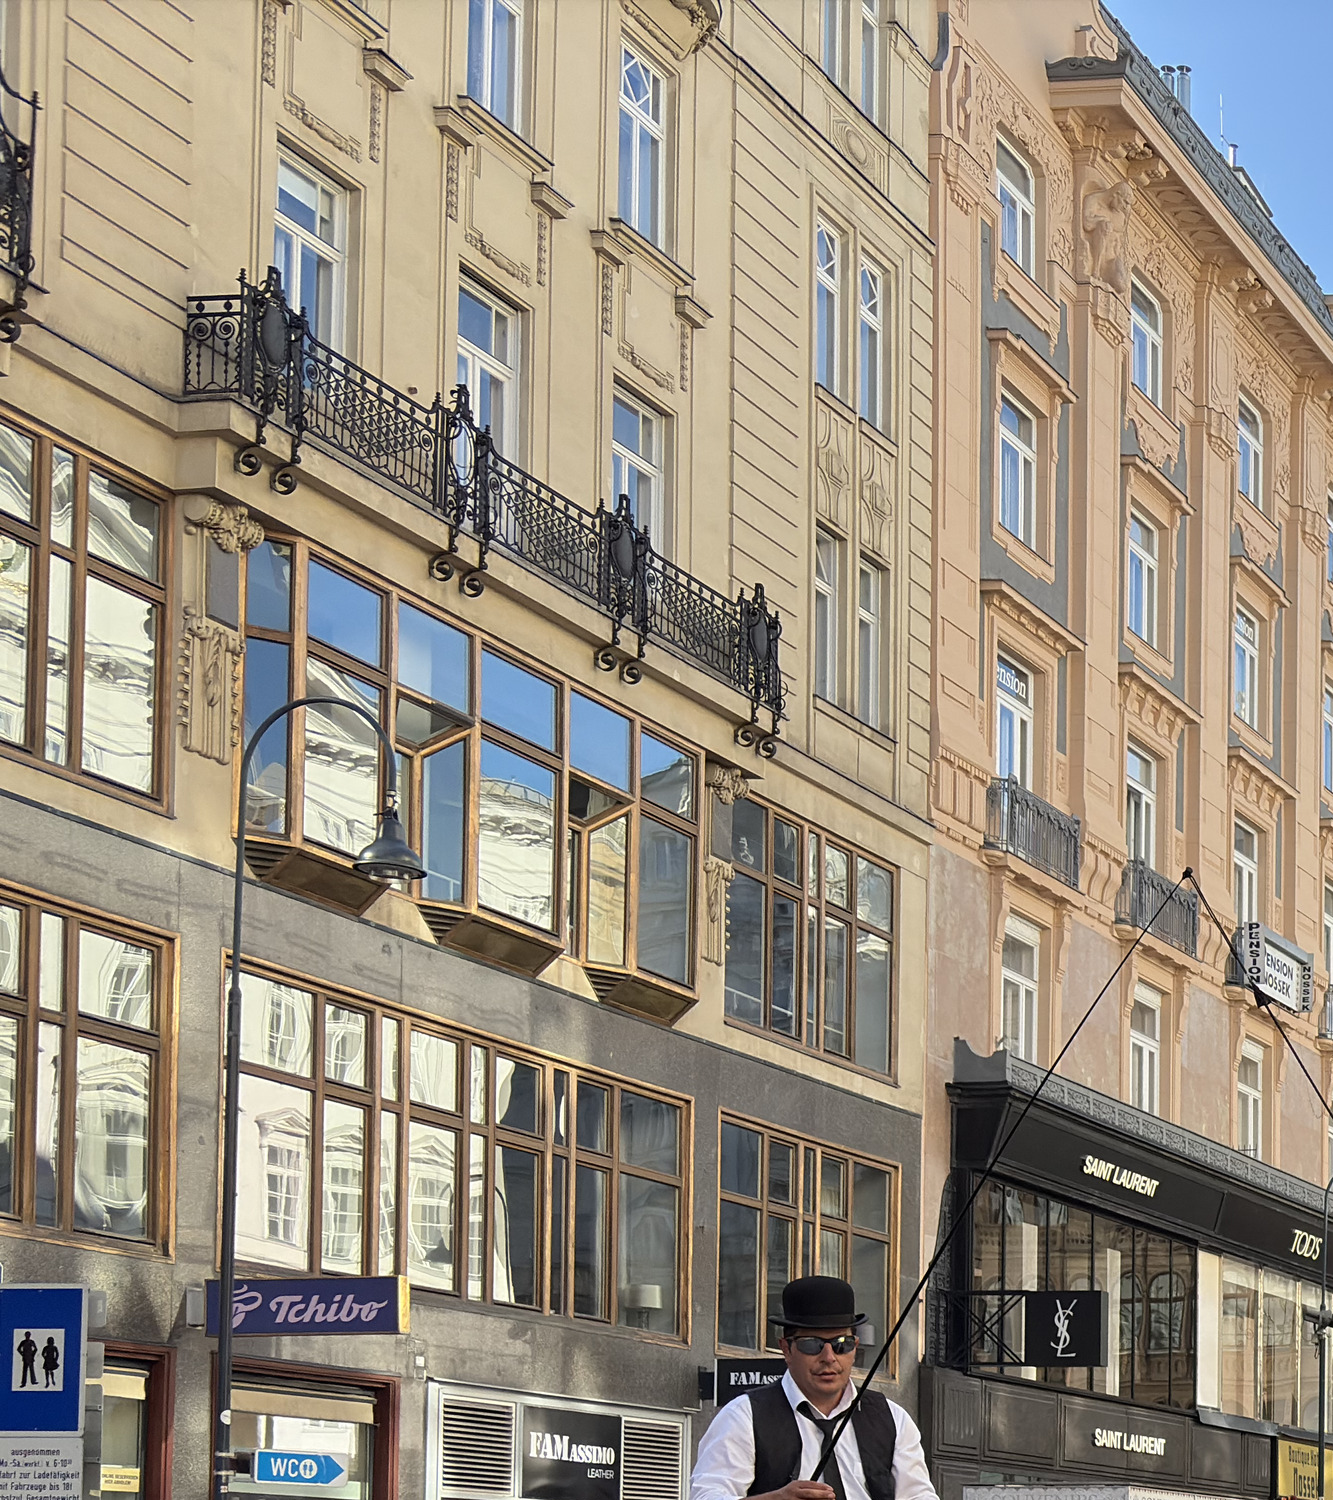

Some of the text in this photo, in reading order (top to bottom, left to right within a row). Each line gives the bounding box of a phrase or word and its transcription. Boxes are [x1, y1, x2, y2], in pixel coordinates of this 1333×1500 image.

[1247, 922, 1261, 983] PENSION
[1265, 946, 1294, 981] ENSION
[1302, 966, 1312, 1011] NOSSEK
[1083, 1154, 1160, 1198] SAINT LAURENT
[1290, 1229, 1323, 1261] TOD'S
[269, 1293, 389, 1324] Tchibo
[11, 1449, 61, 1458] ausgenommen
[1094, 1427, 1166, 1456] SAINT LAURENT
[33, 1471, 80, 1481] Ladetätigkeit
[270, 1457, 299, 1478] WC
[587, 1468, 615, 1480] LEATHER
[11, 1482, 46, 1492] Fahrzeuge
[49, 1482, 60, 1490] bis
